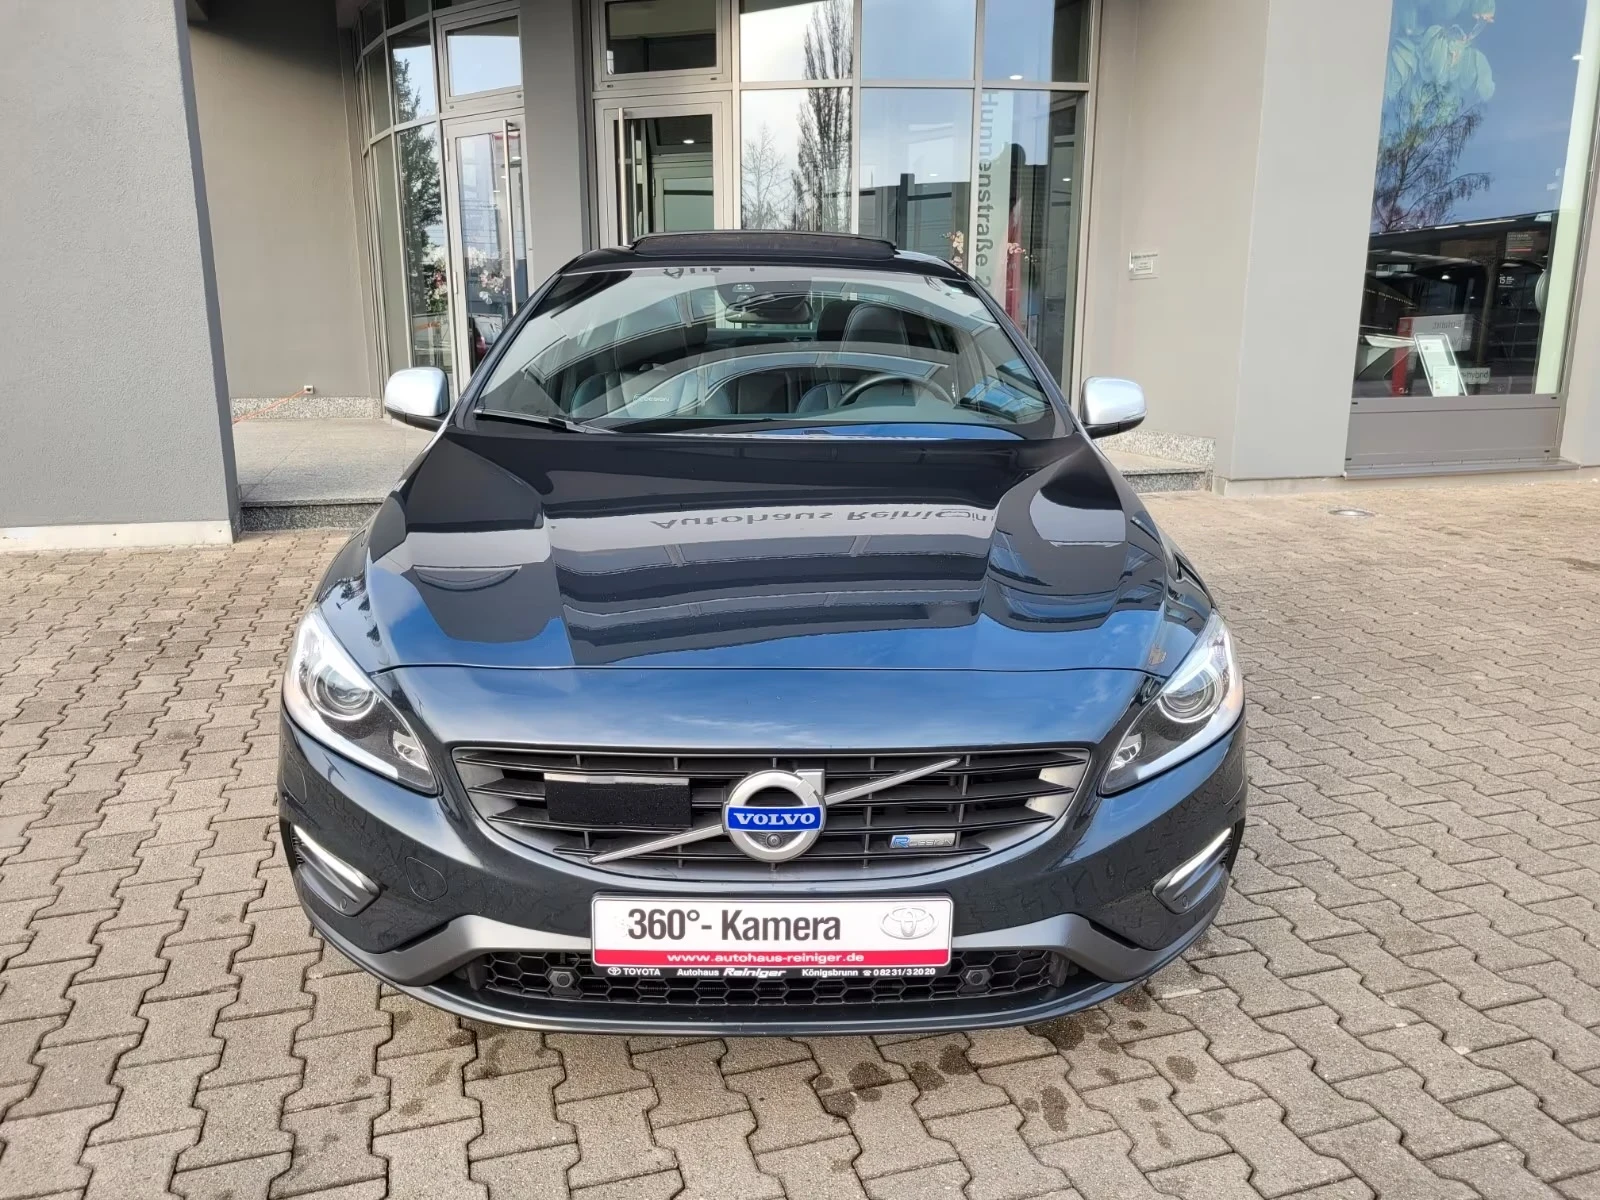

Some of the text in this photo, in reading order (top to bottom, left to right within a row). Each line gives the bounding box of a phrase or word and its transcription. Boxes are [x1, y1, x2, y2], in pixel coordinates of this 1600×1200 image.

[732, 812, 816, 826] VOLVO
[721, 909, 841, 941] Kamera
[666, 951, 865, 965] www.autohaus-reiniger.de
[623, 967, 661, 976] TOYOTA
[676, 968, 719, 977] Autohaus
[723, 967, 787, 979] Reiniger
[801, 968, 859, 978] Königsbrunn
